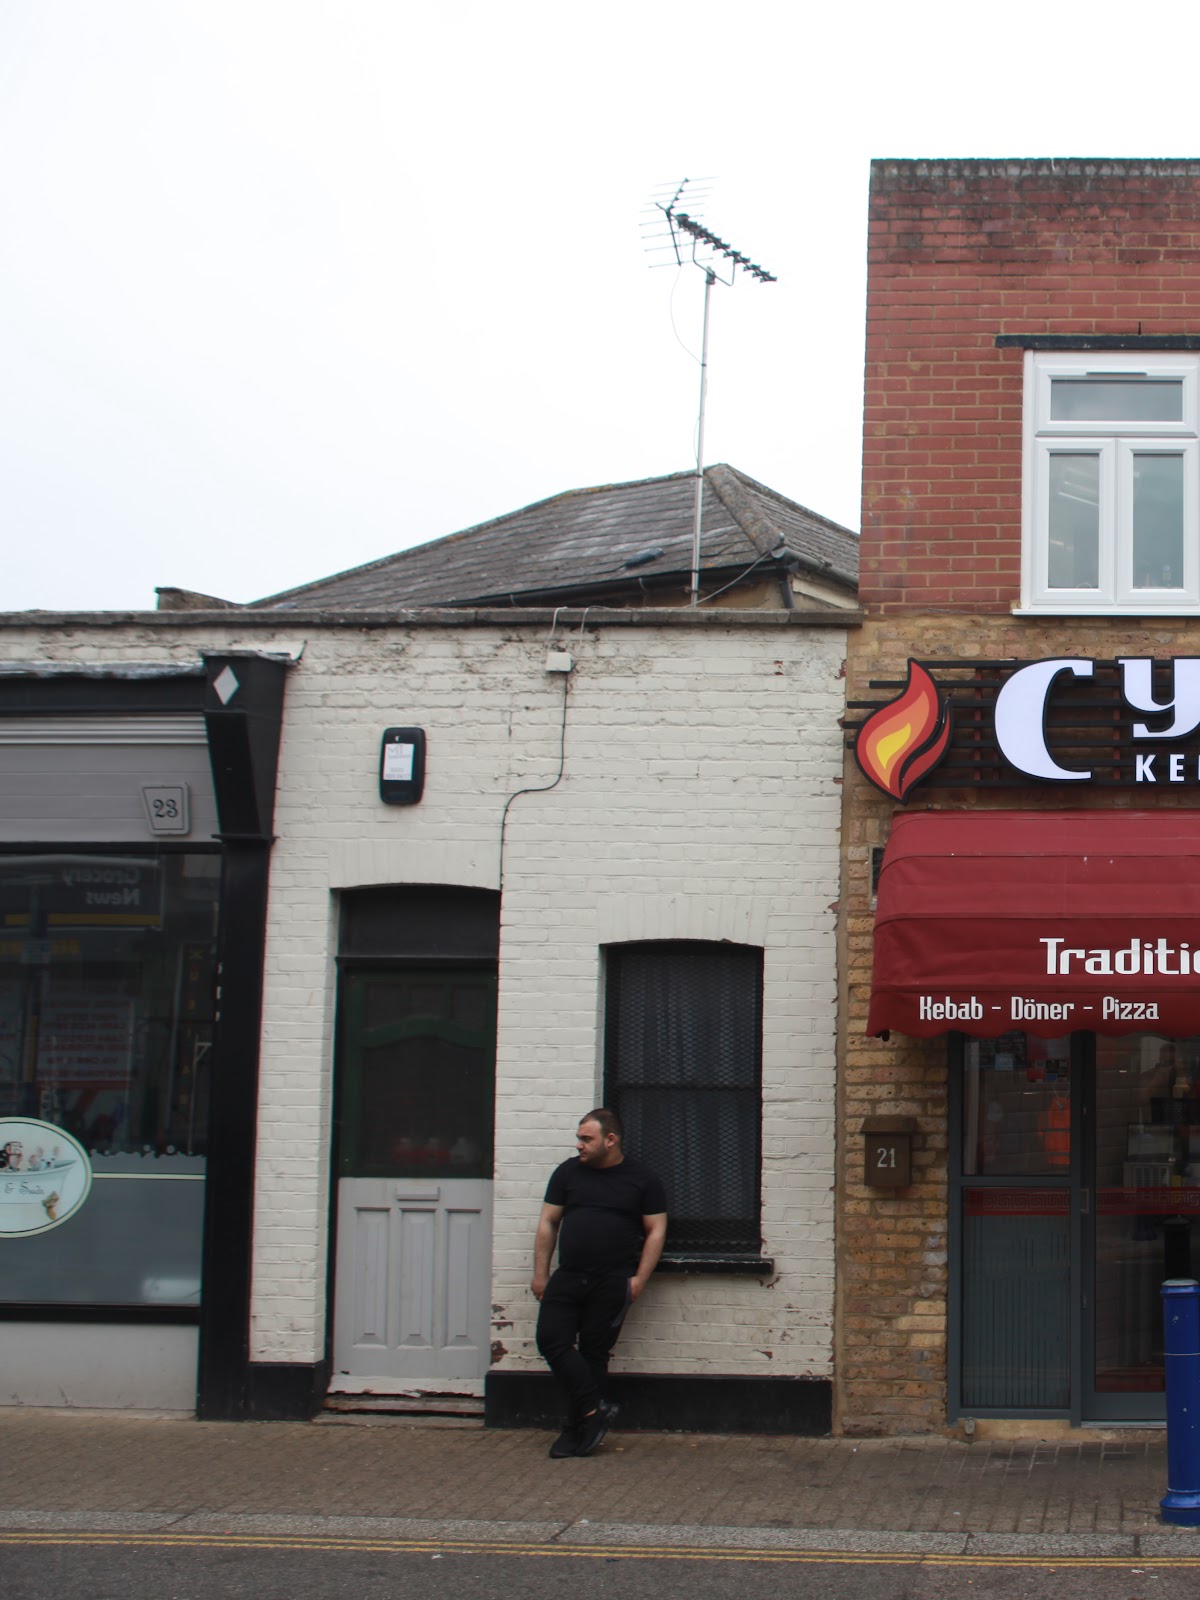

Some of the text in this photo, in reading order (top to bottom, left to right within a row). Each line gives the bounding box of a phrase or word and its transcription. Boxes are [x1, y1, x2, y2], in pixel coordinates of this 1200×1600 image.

[153, 798, 178, 819] 23
[919, 996, 983, 1021] Kebab
[1011, 996, 1075, 1021] Döner
[1102, 996, 1160, 1021] Pizza
[877, 1147, 897, 1168] 21
